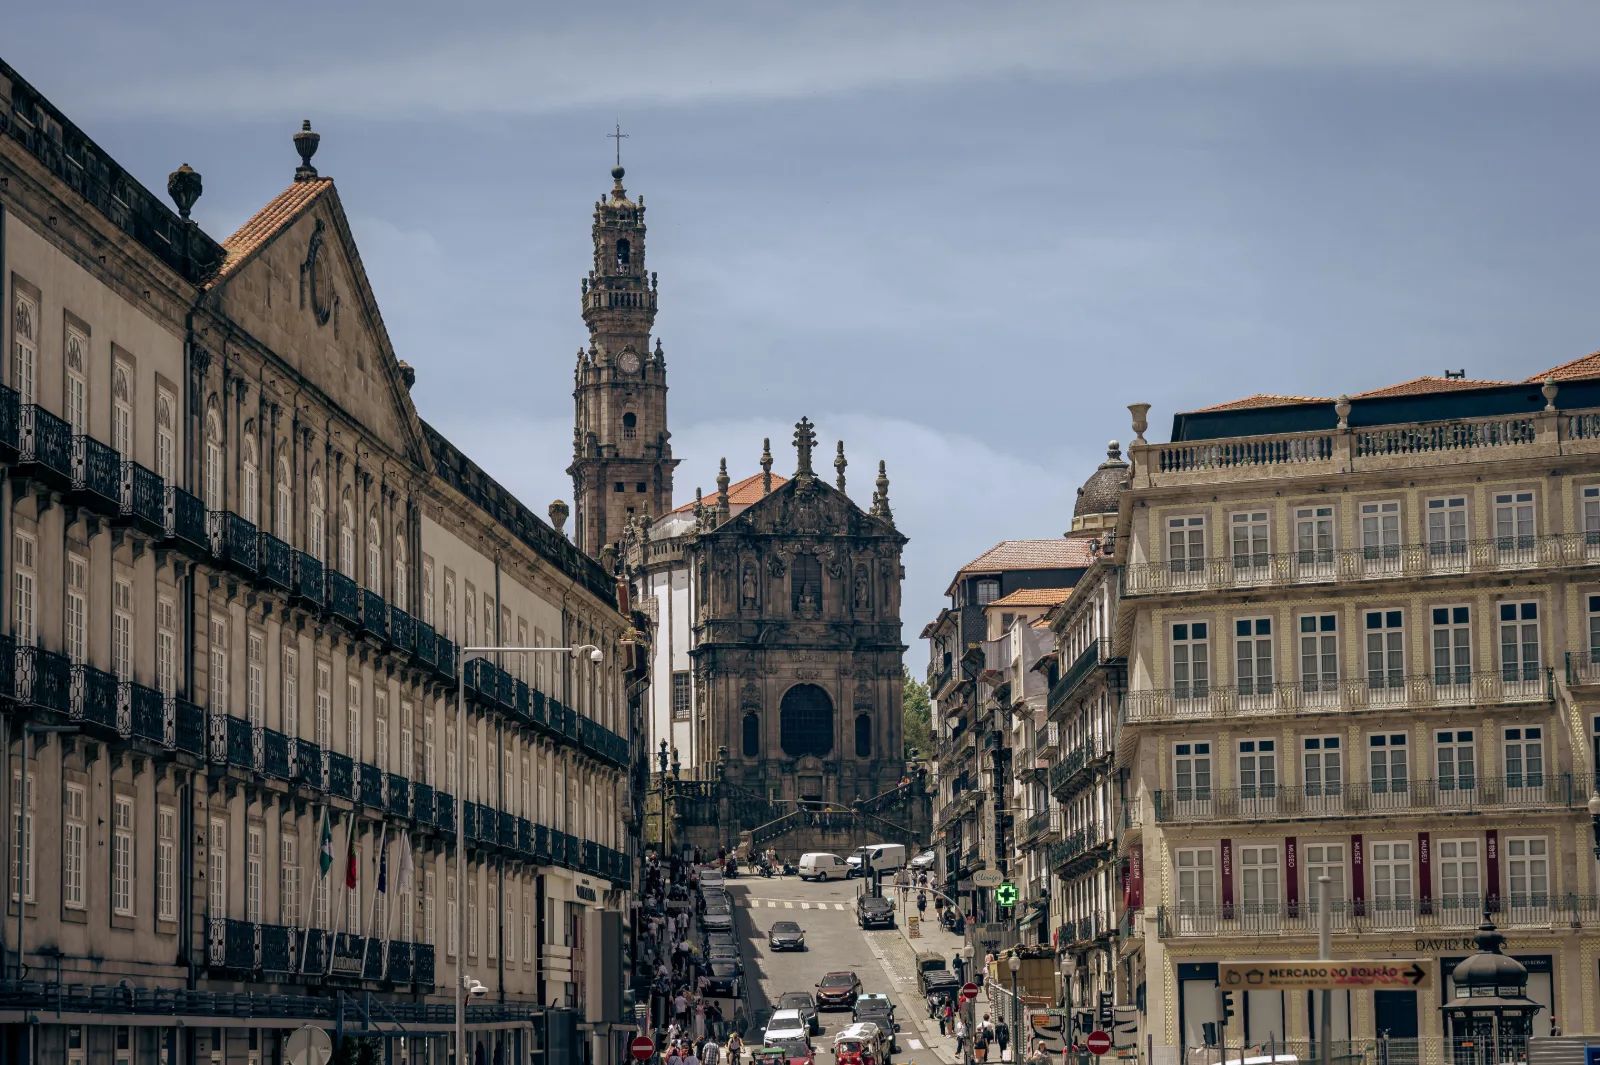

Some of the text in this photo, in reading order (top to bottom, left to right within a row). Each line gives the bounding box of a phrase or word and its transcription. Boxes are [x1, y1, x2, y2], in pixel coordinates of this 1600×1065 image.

[1354, 842, 1362, 864] MUSÉE
[1415, 938, 1457, 951] DAVID
[1269, 966, 1398, 978] MERCADO DO BOLHÃO
